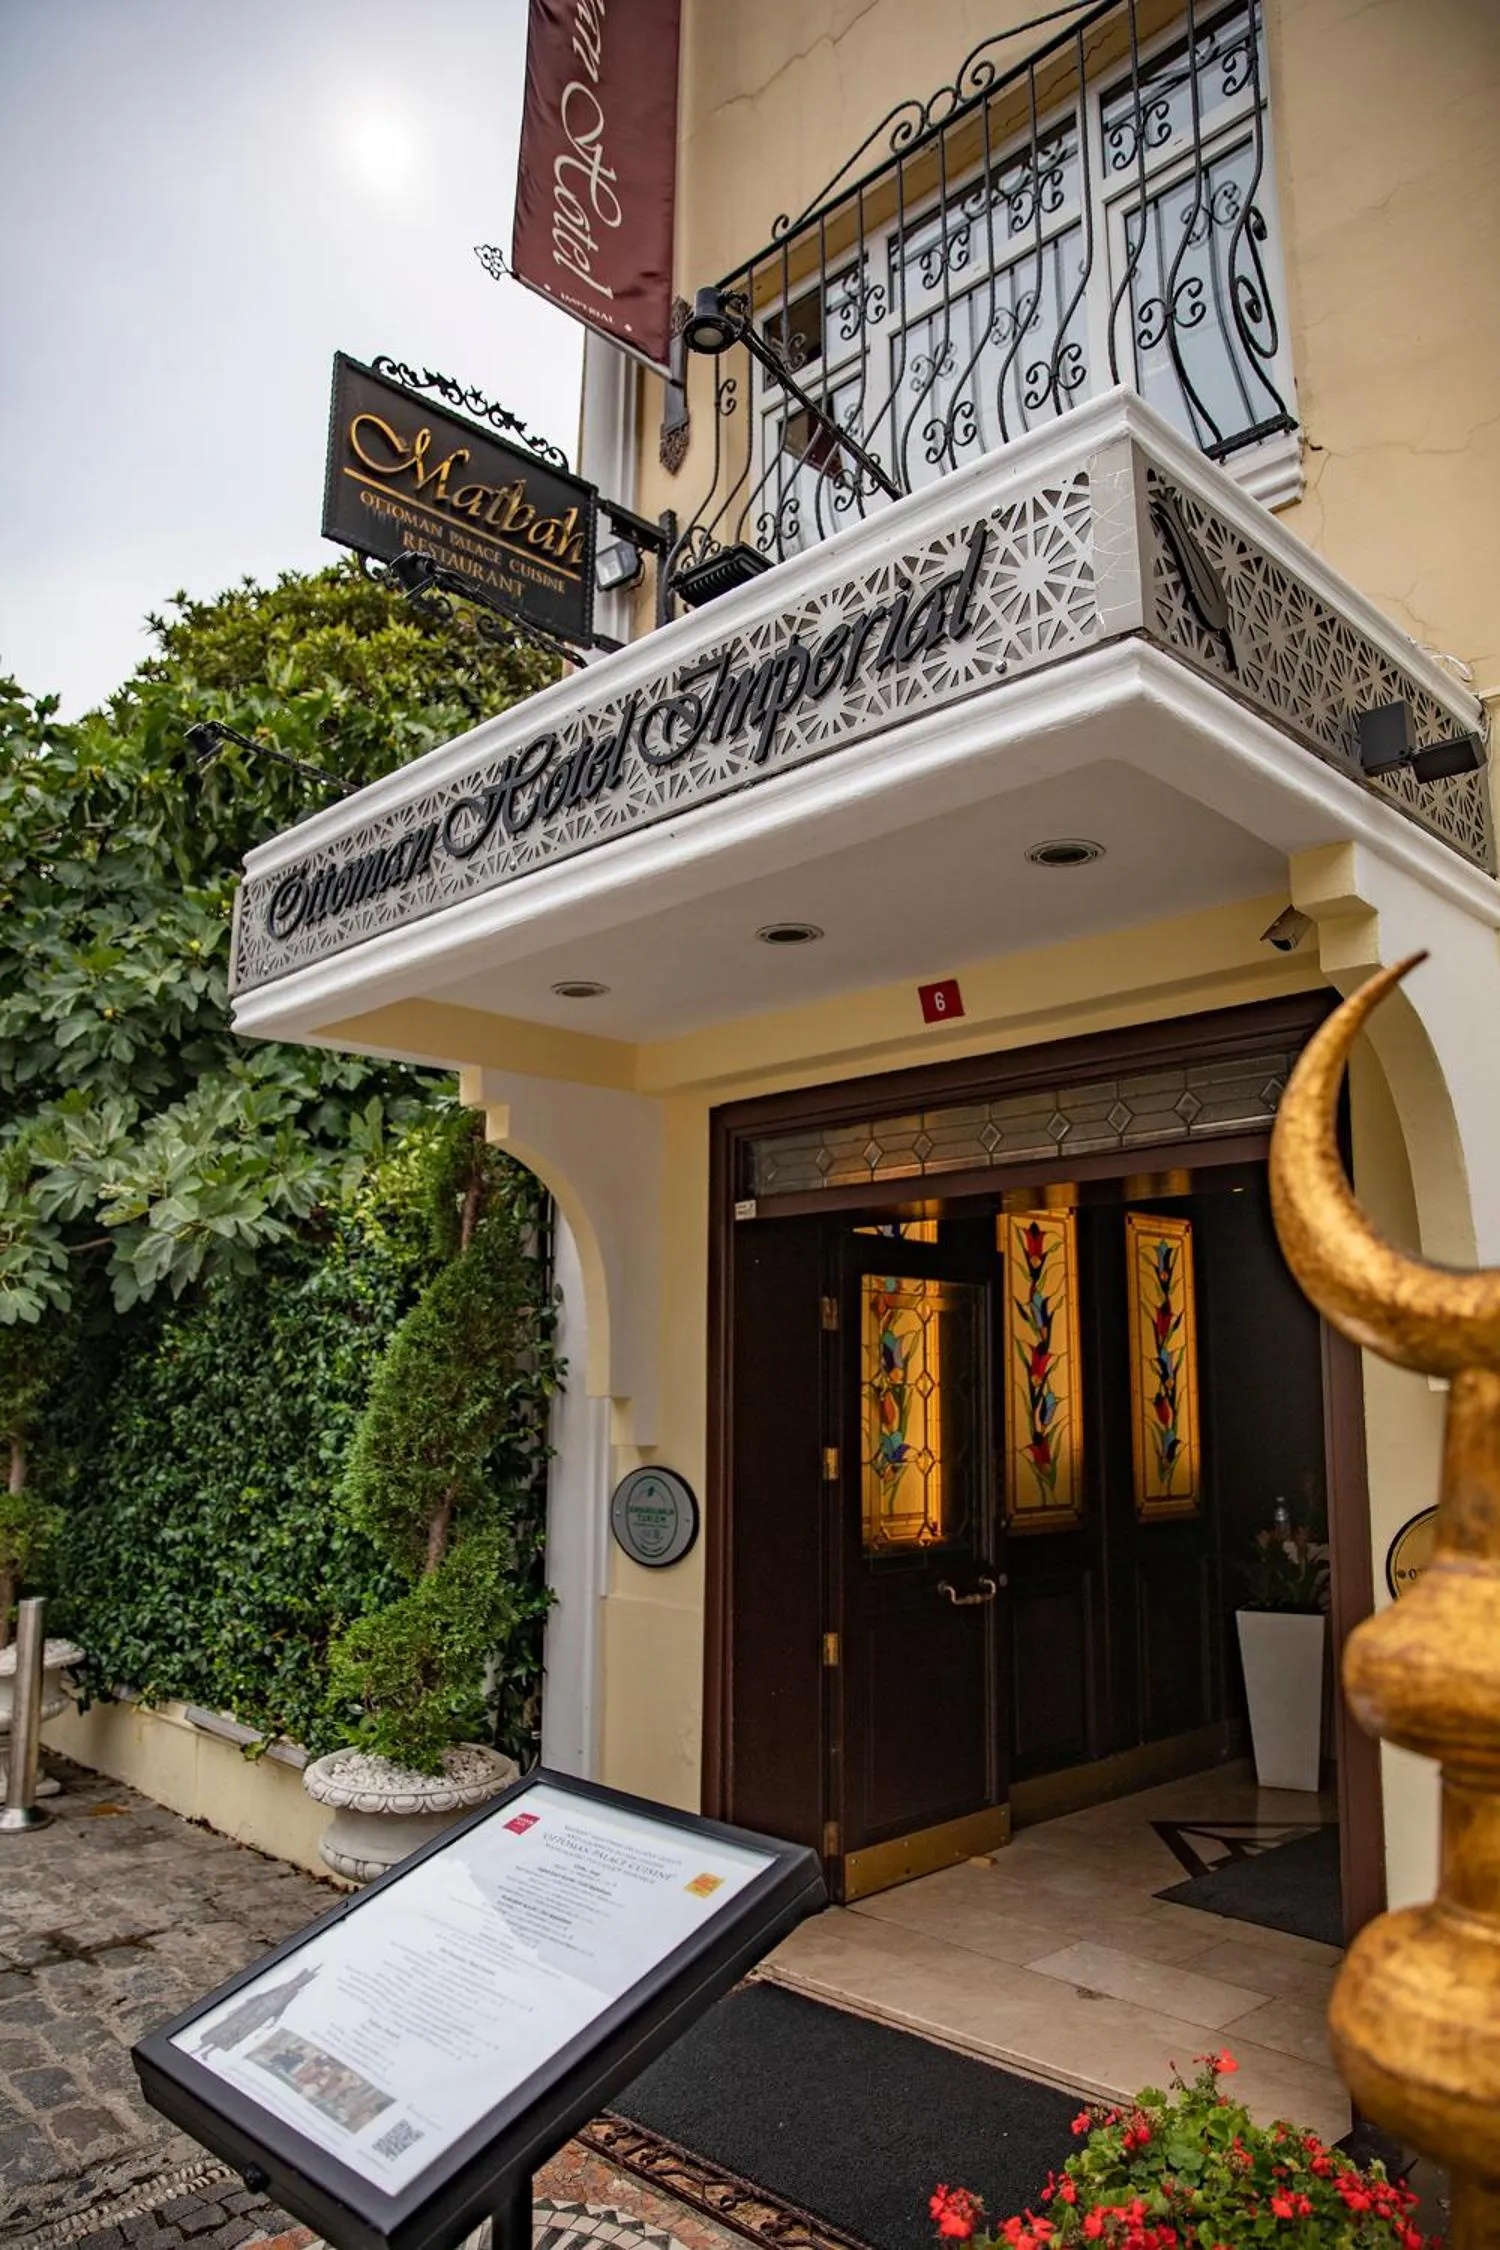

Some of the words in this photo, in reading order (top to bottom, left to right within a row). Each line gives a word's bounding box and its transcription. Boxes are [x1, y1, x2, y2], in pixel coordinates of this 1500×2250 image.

[552, 82, 622, 300] Hotel
[350, 413, 586, 565] Matbah
[360, 489, 444, 539] OTTOMAN
[449, 527, 502, 566] PALACE
[509, 554, 566, 594] CUISINE
[402, 528, 526, 598] RESTAURANT
[267, 820, 440, 940] Ottoman
[442, 699, 637, 858] Hotel
[638, 519, 988, 765] Imperial
[934, 991, 947, 1012] 6
